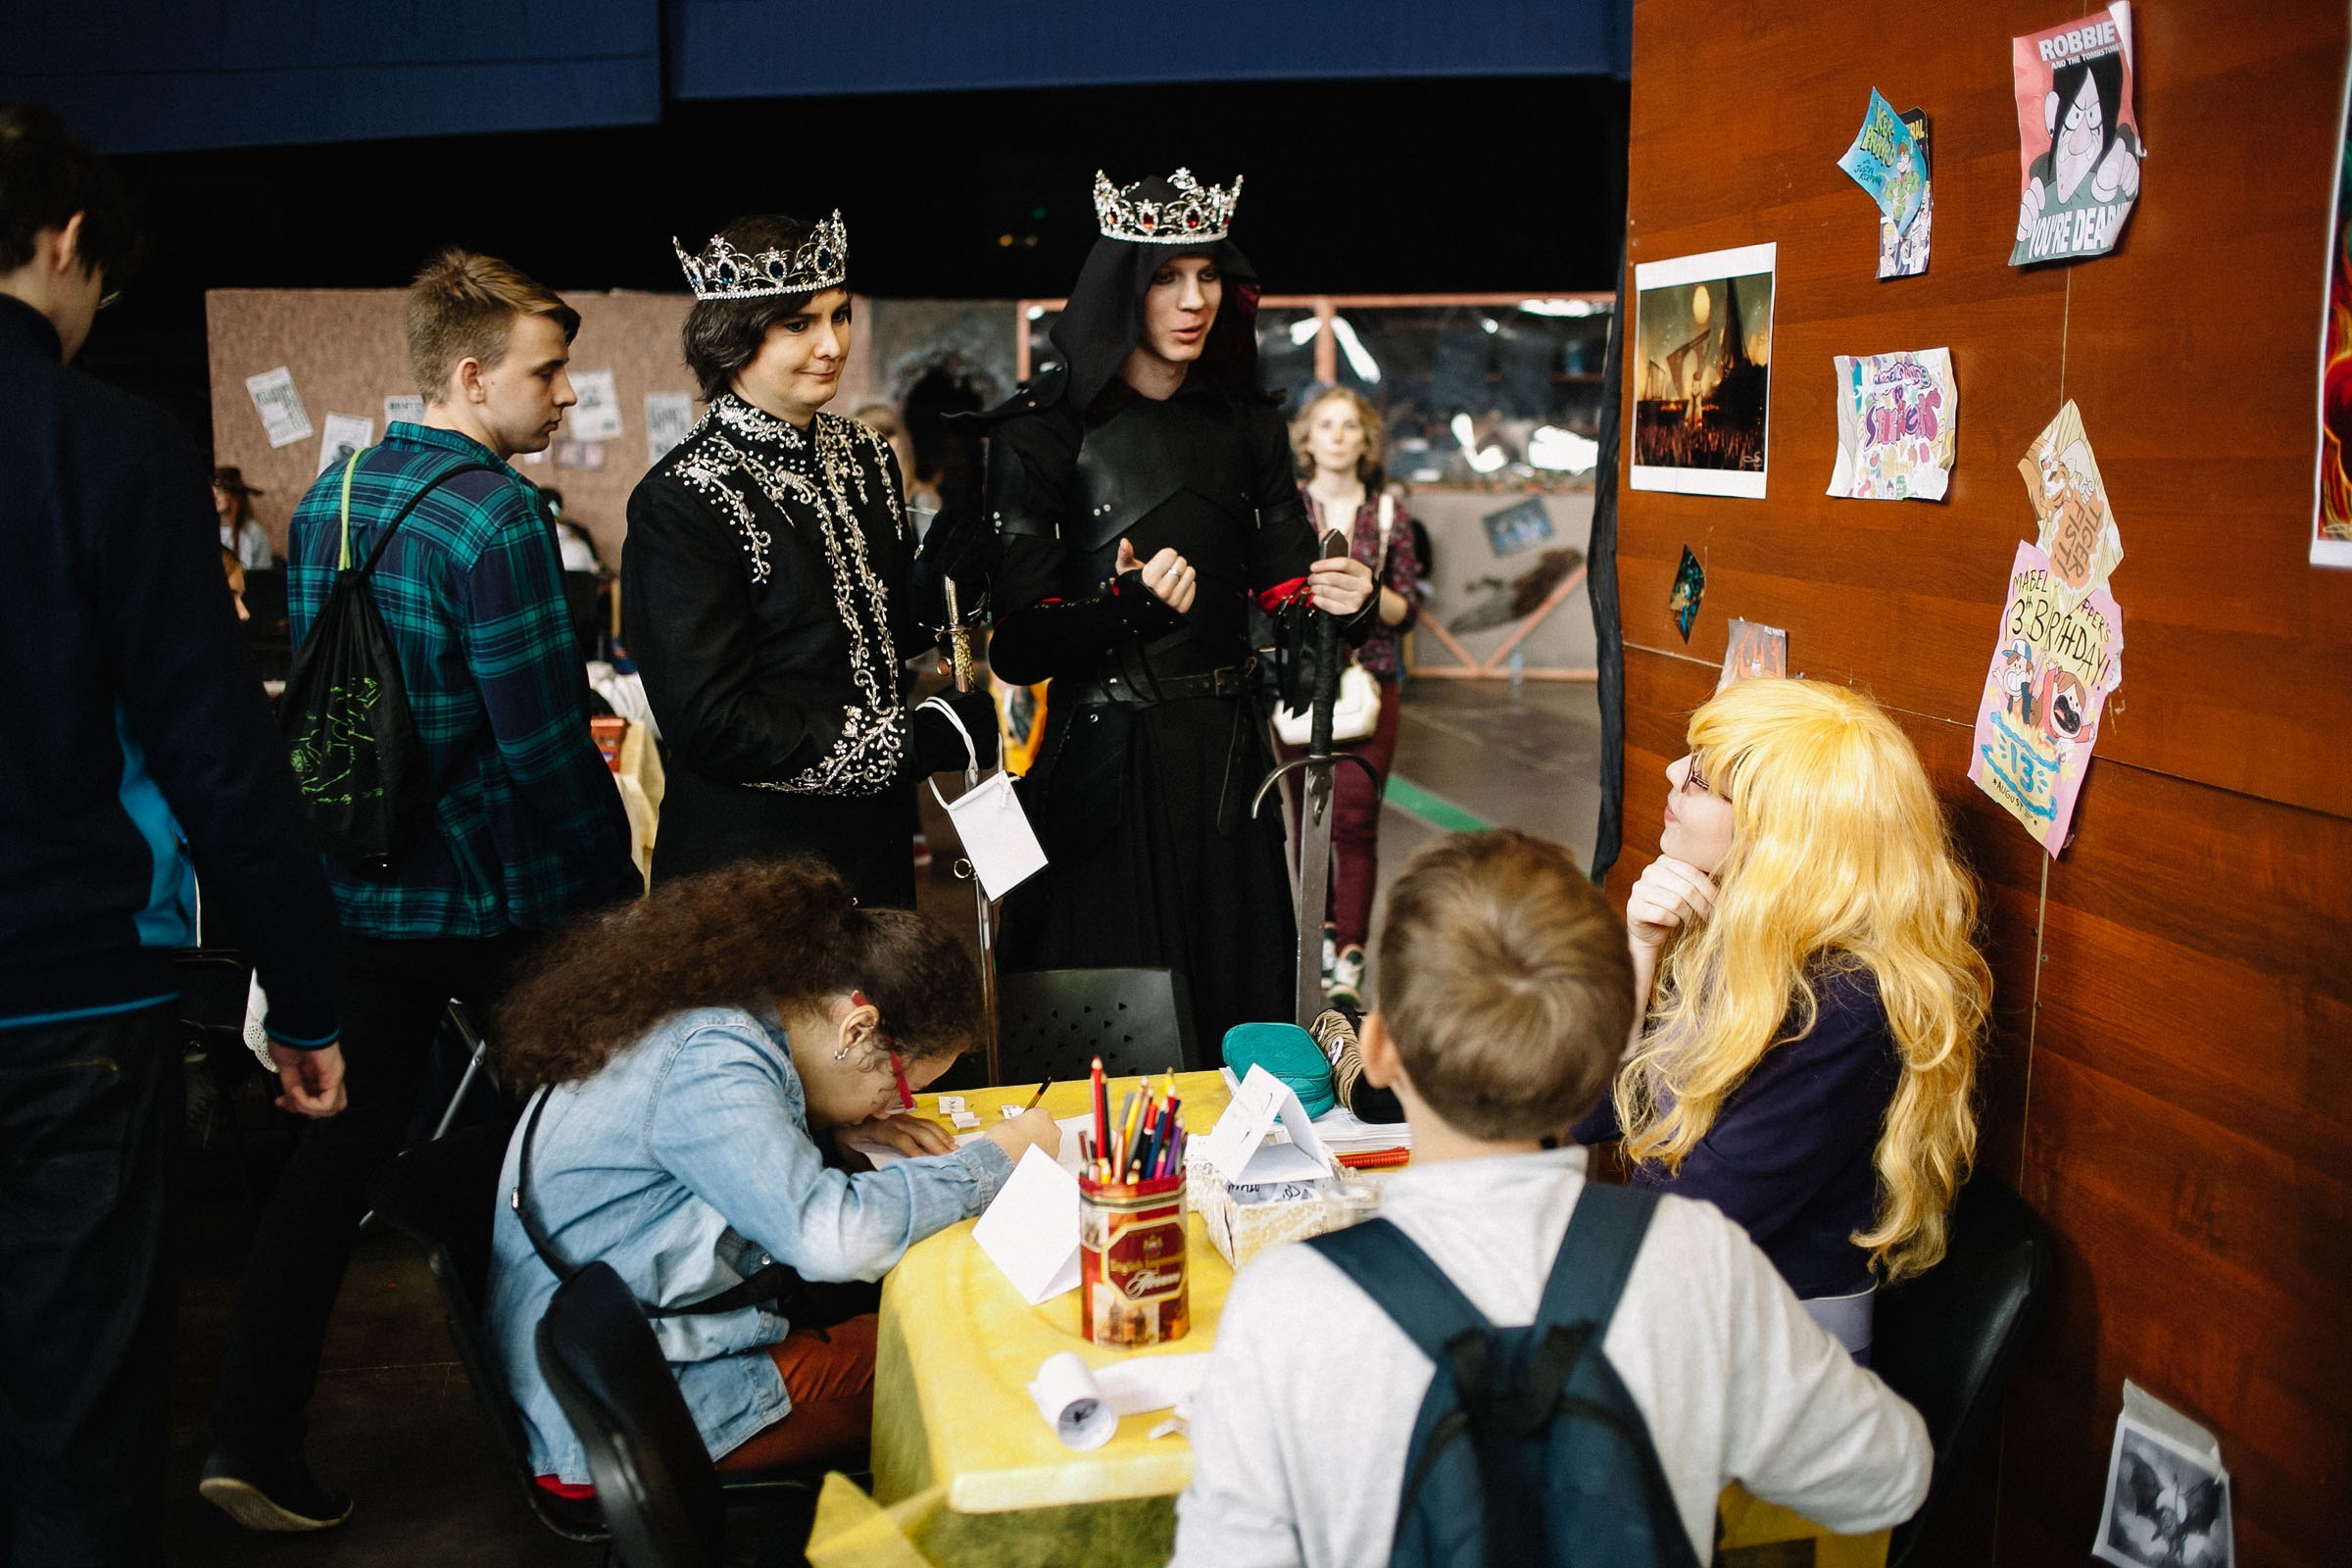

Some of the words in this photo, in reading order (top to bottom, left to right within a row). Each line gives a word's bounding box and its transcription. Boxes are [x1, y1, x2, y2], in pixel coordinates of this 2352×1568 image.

[2038, 20, 2116, 62] ROBBIE
[2051, 59, 2067, 71] AND
[2067, 54, 2082, 67] THE
[2082, 43, 2125, 62] TOMBSTONES
[2027, 211, 2073, 259] YOU'RE
[2054, 499, 2085, 578] FIST!
[2068, 506, 2101, 578] TIGER
[2013, 569, 2048, 596] MABEL
[2010, 742, 2034, 793] 13
[1996, 782, 2024, 811] AUGUST
